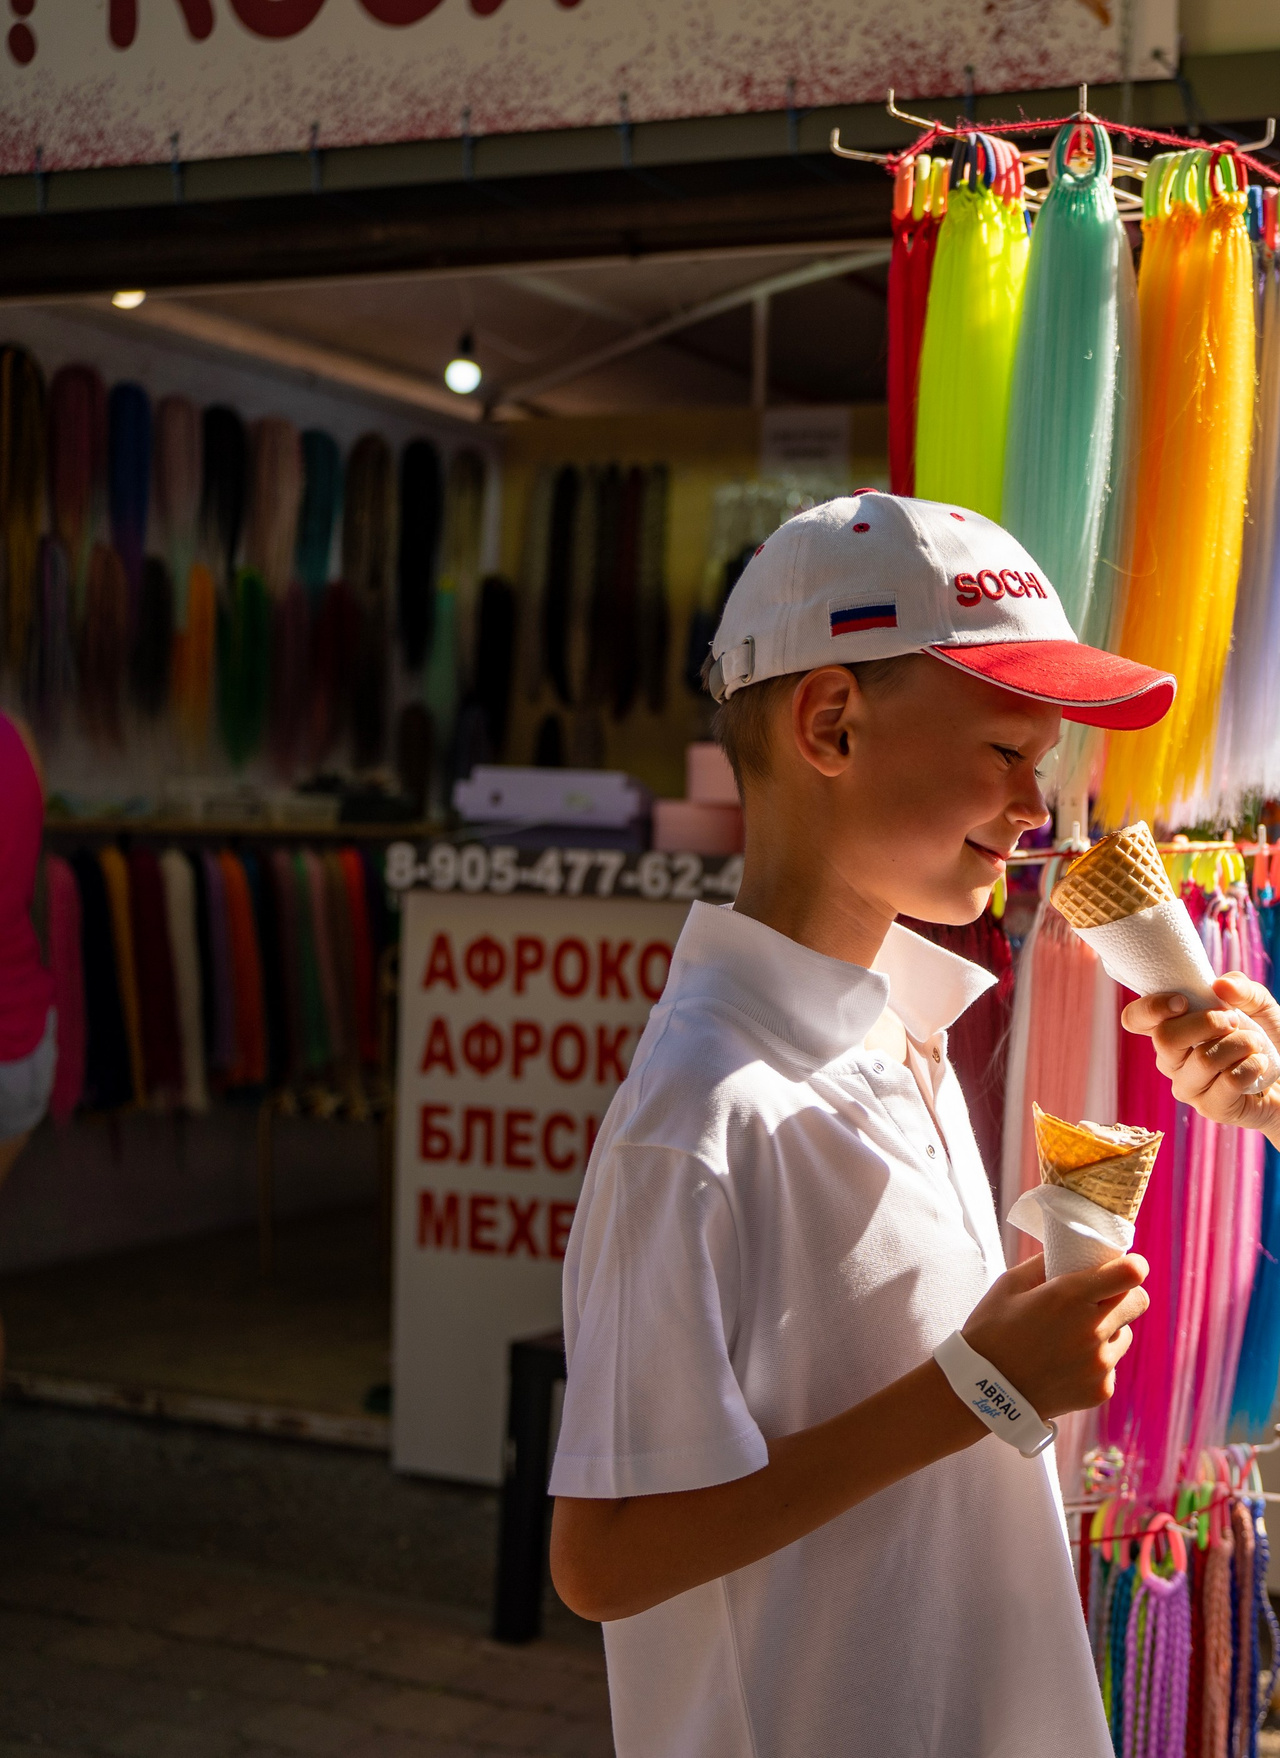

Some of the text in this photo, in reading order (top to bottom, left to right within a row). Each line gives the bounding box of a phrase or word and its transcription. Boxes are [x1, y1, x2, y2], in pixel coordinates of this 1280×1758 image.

[954, 568, 1049, 608] SOCHI
[420, 1015, 643, 1084] АФРОК
[972, 1397, 1001, 1418] Light
[975, 1379, 1021, 1421] ABRAU
